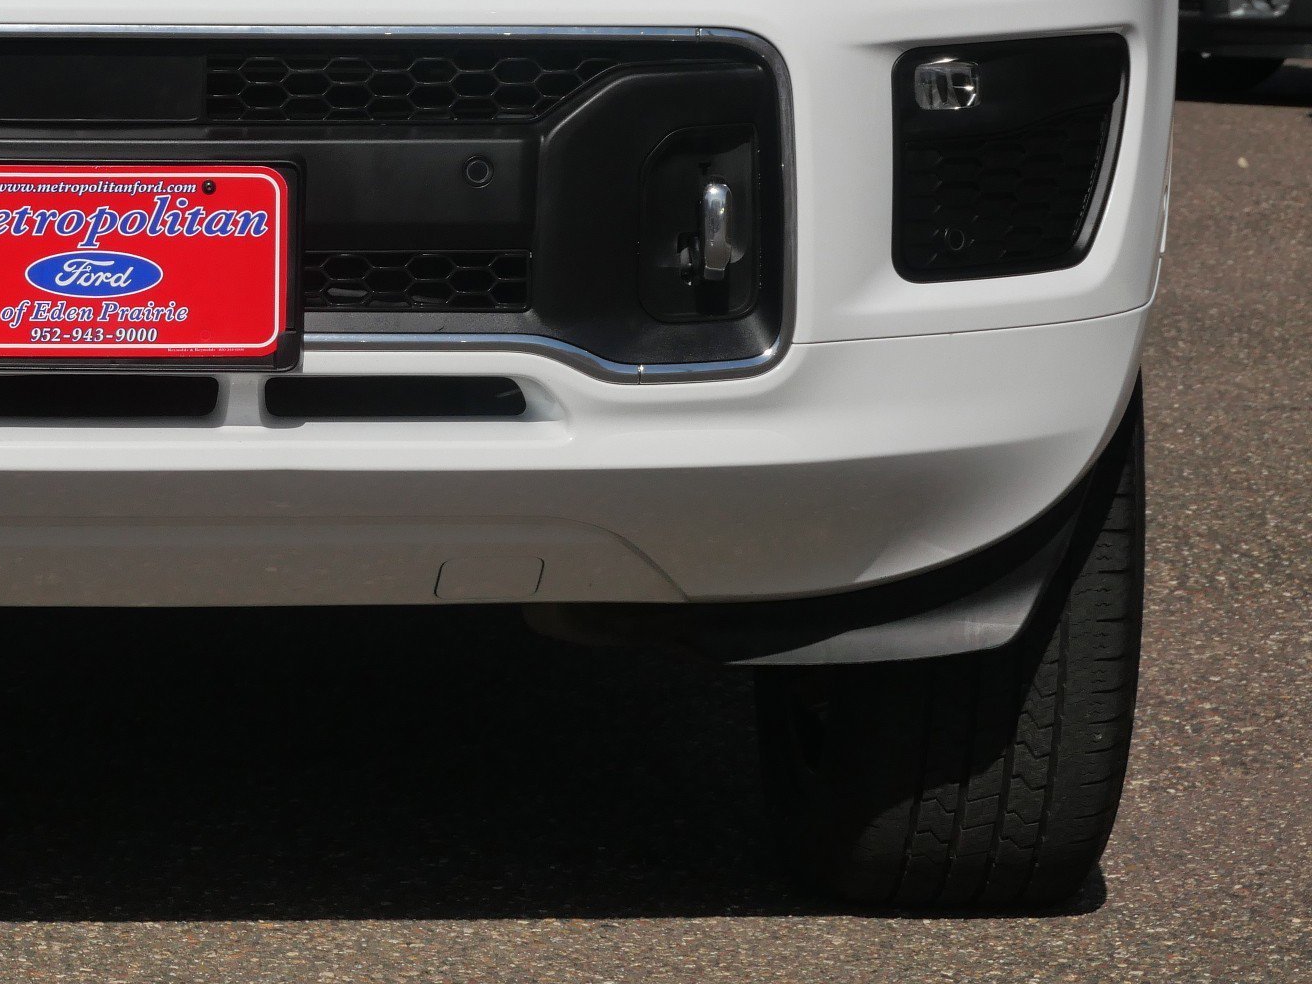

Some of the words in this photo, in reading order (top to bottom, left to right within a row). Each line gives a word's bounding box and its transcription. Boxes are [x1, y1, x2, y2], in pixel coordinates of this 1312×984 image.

[55, 257, 134, 288] Ford
[0, 300, 31, 328] of
[29, 300, 94, 322] Eden
[97, 301, 188, 323] Prairie
[30, 327, 158, 343] 952-943-9000
